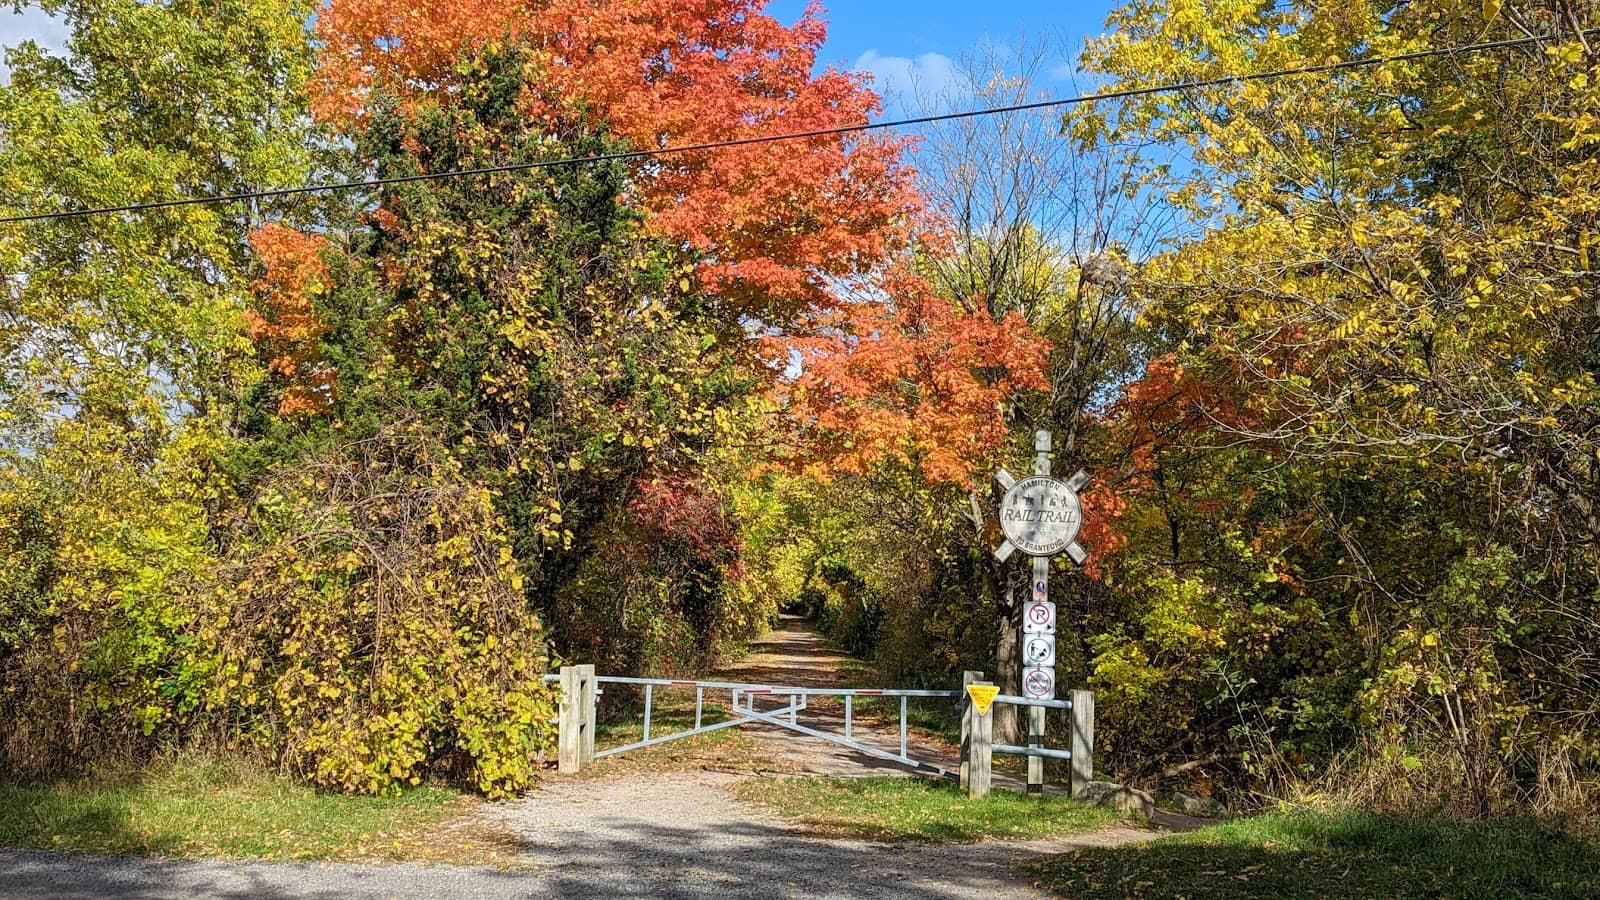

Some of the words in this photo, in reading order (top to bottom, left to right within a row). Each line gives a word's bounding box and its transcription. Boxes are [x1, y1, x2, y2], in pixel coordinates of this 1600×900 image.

[1021, 480, 1060, 491] HAMILTON
[1004, 509, 1034, 522] RAIL
[1036, 510, 1076, 523] TRAIL
[1025, 539, 1064, 552] BRANTFORD
